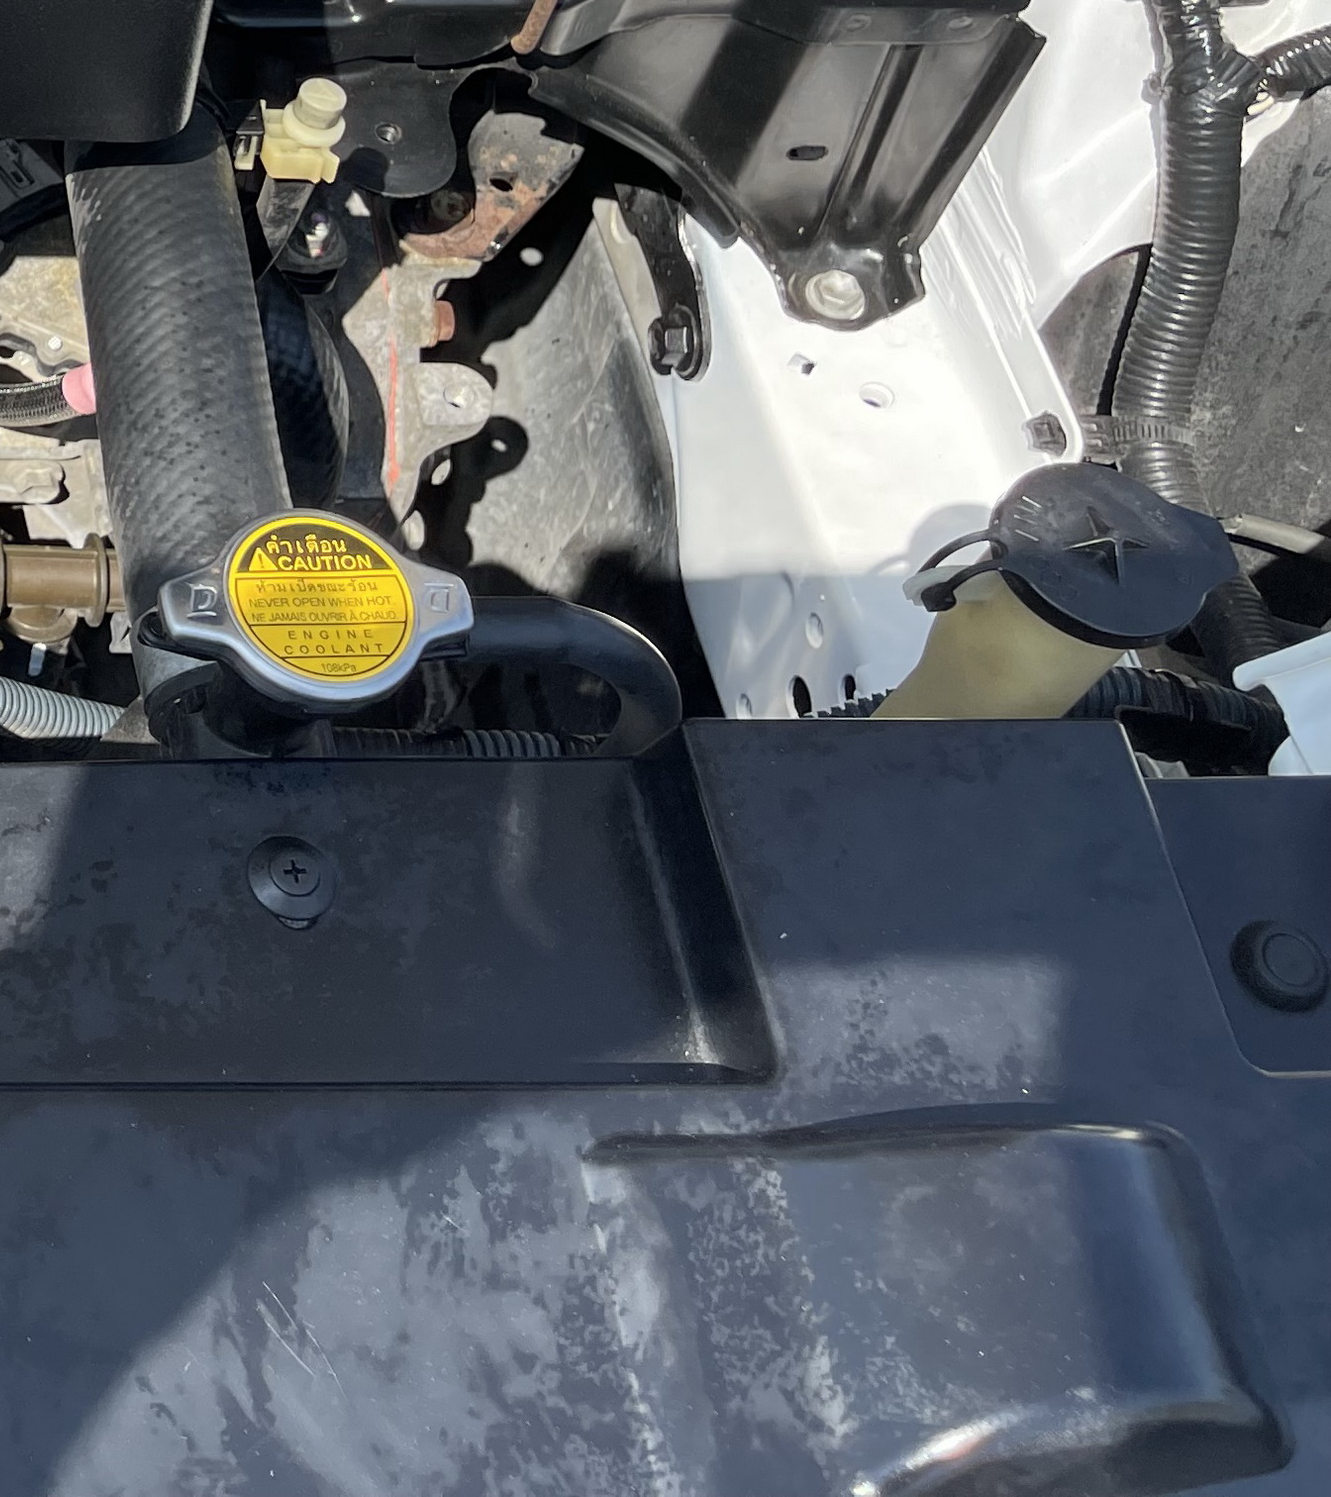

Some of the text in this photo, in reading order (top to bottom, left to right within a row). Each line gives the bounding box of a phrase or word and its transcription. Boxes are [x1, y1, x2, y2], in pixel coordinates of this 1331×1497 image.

[266, 534, 347, 554] คำเตือน
[277, 554, 373, 571] CAUTION
[249, 597, 290, 609] NEVER
[292, 597, 326, 608] OPEN
[328, 596, 364, 607] WHEN
[252, 612, 266, 623] NE
[269, 612, 308, 622] JAMAIS
[309, 611, 347, 622] OUVRIR
[288, 629, 374, 640] ENGINE
[283, 643, 384, 655] COOLANT
[321, 663, 357, 673] 108kPa
